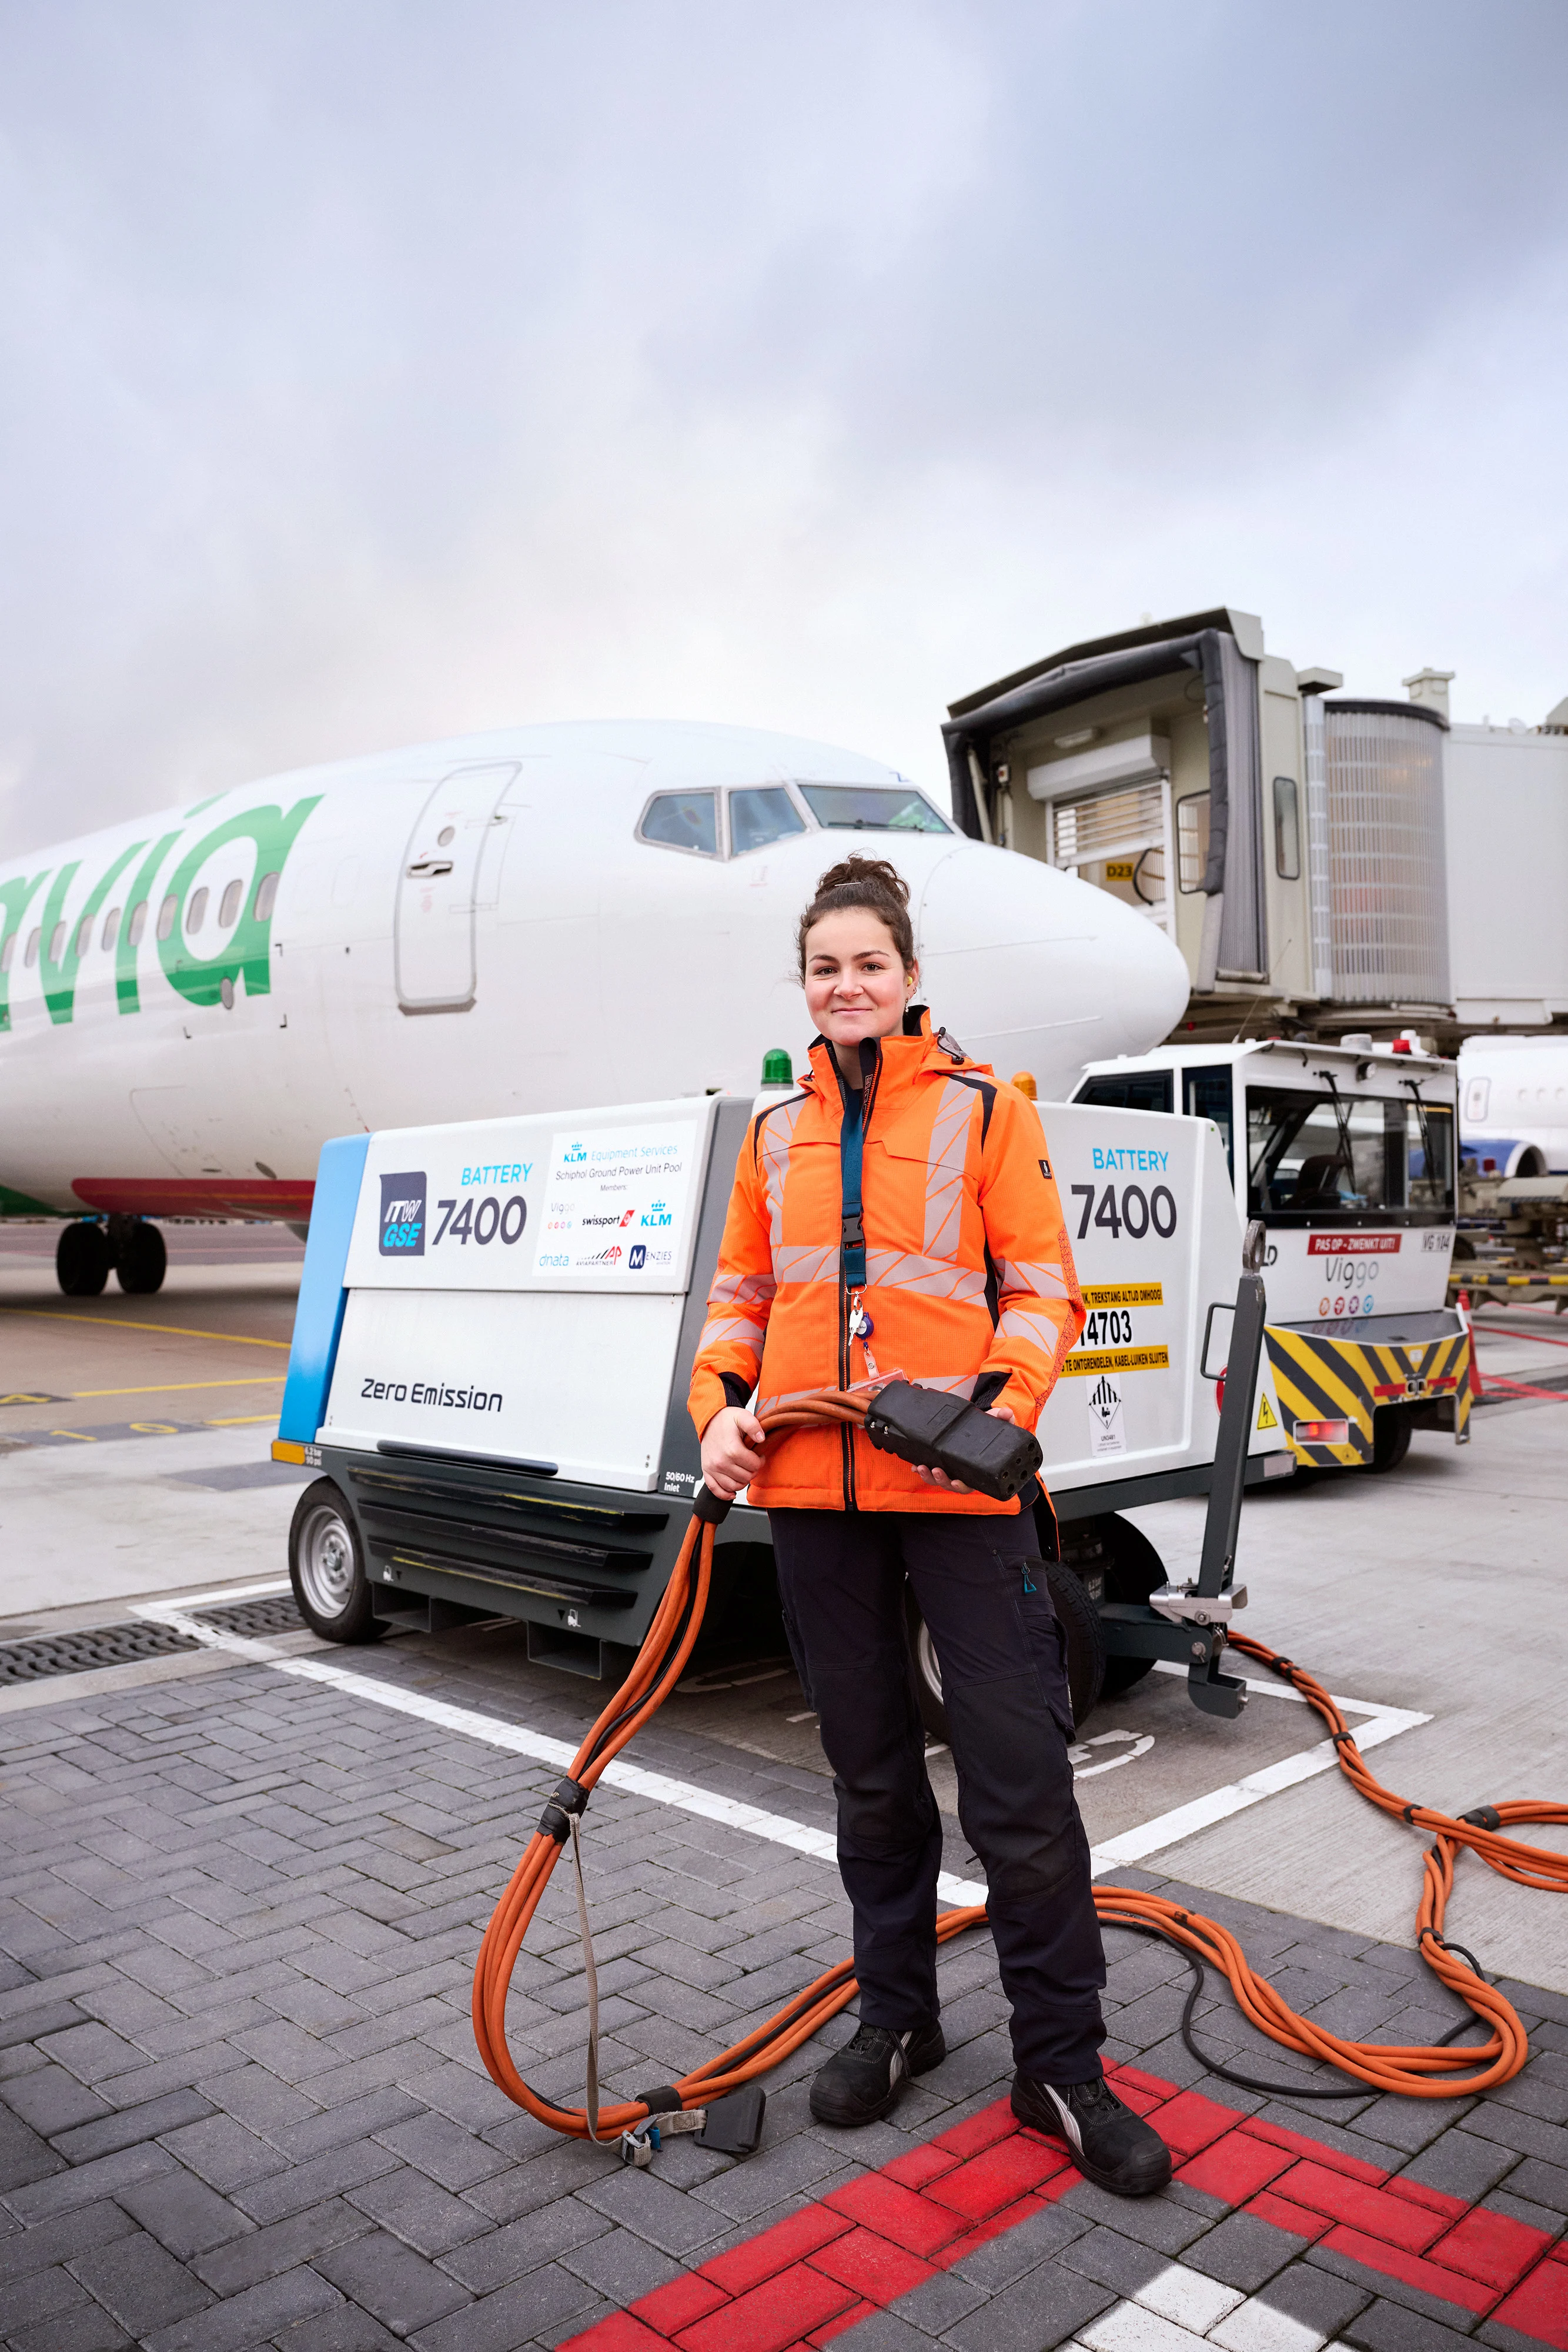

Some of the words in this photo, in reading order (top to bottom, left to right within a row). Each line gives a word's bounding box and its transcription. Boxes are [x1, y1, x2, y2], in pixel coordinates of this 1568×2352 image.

[1107, 865, 1132, 877] D23
[564, 1152, 587, 1162] KLM
[591, 1148, 637, 1161] Equipment
[640, 1145, 678, 1157] Services
[1092, 1148, 1169, 1171] BATTERY
[461, 1162, 533, 1185] BATTERY
[556, 1169, 587, 1181] Schiphol
[589, 1168, 616, 1178] Ground
[618, 1166, 643, 1176] Power
[646, 1164, 661, 1174] Unit
[664, 1162, 682, 1172] Pool
[384, 1200, 422, 1222] ITW
[551, 1202, 575, 1215] Viggo
[1071, 1184, 1176, 1239] 7400
[432, 1195, 527, 1245] 7400
[582, 1215, 620, 1227] swissport
[641, 1214, 672, 1226] KLM
[383, 1223, 422, 1247] GSE
[1315, 1238, 1331, 1251] PAS
[1331, 1238, 1343, 1251] OP
[1347, 1237, 1379, 1251] ZWENKT
[539, 1254, 569, 1267] dnata
[1326, 1257, 1379, 1289] Viggo
[1091, 1291, 1121, 1304] TREKSTANG
[1122, 1289, 1139, 1302] ALTIJD
[1140, 1288, 1162, 1301] OMHOOG!
[1065, 1359, 1072, 1372] TE
[1073, 1356, 1114, 1372] ONTGRENDELEN,
[1114, 1353, 1148, 1368] KABEL-LUIKEN
[1149, 1352, 1168, 1364] SLUITEN
[361, 1378, 407, 1402] Zero
[411, 1382, 503, 1412] Emission
[666, 1471, 685, 1482] 50/60
[685, 1474, 695, 1484] Hz
[664, 1482, 680, 1492] Inlet
